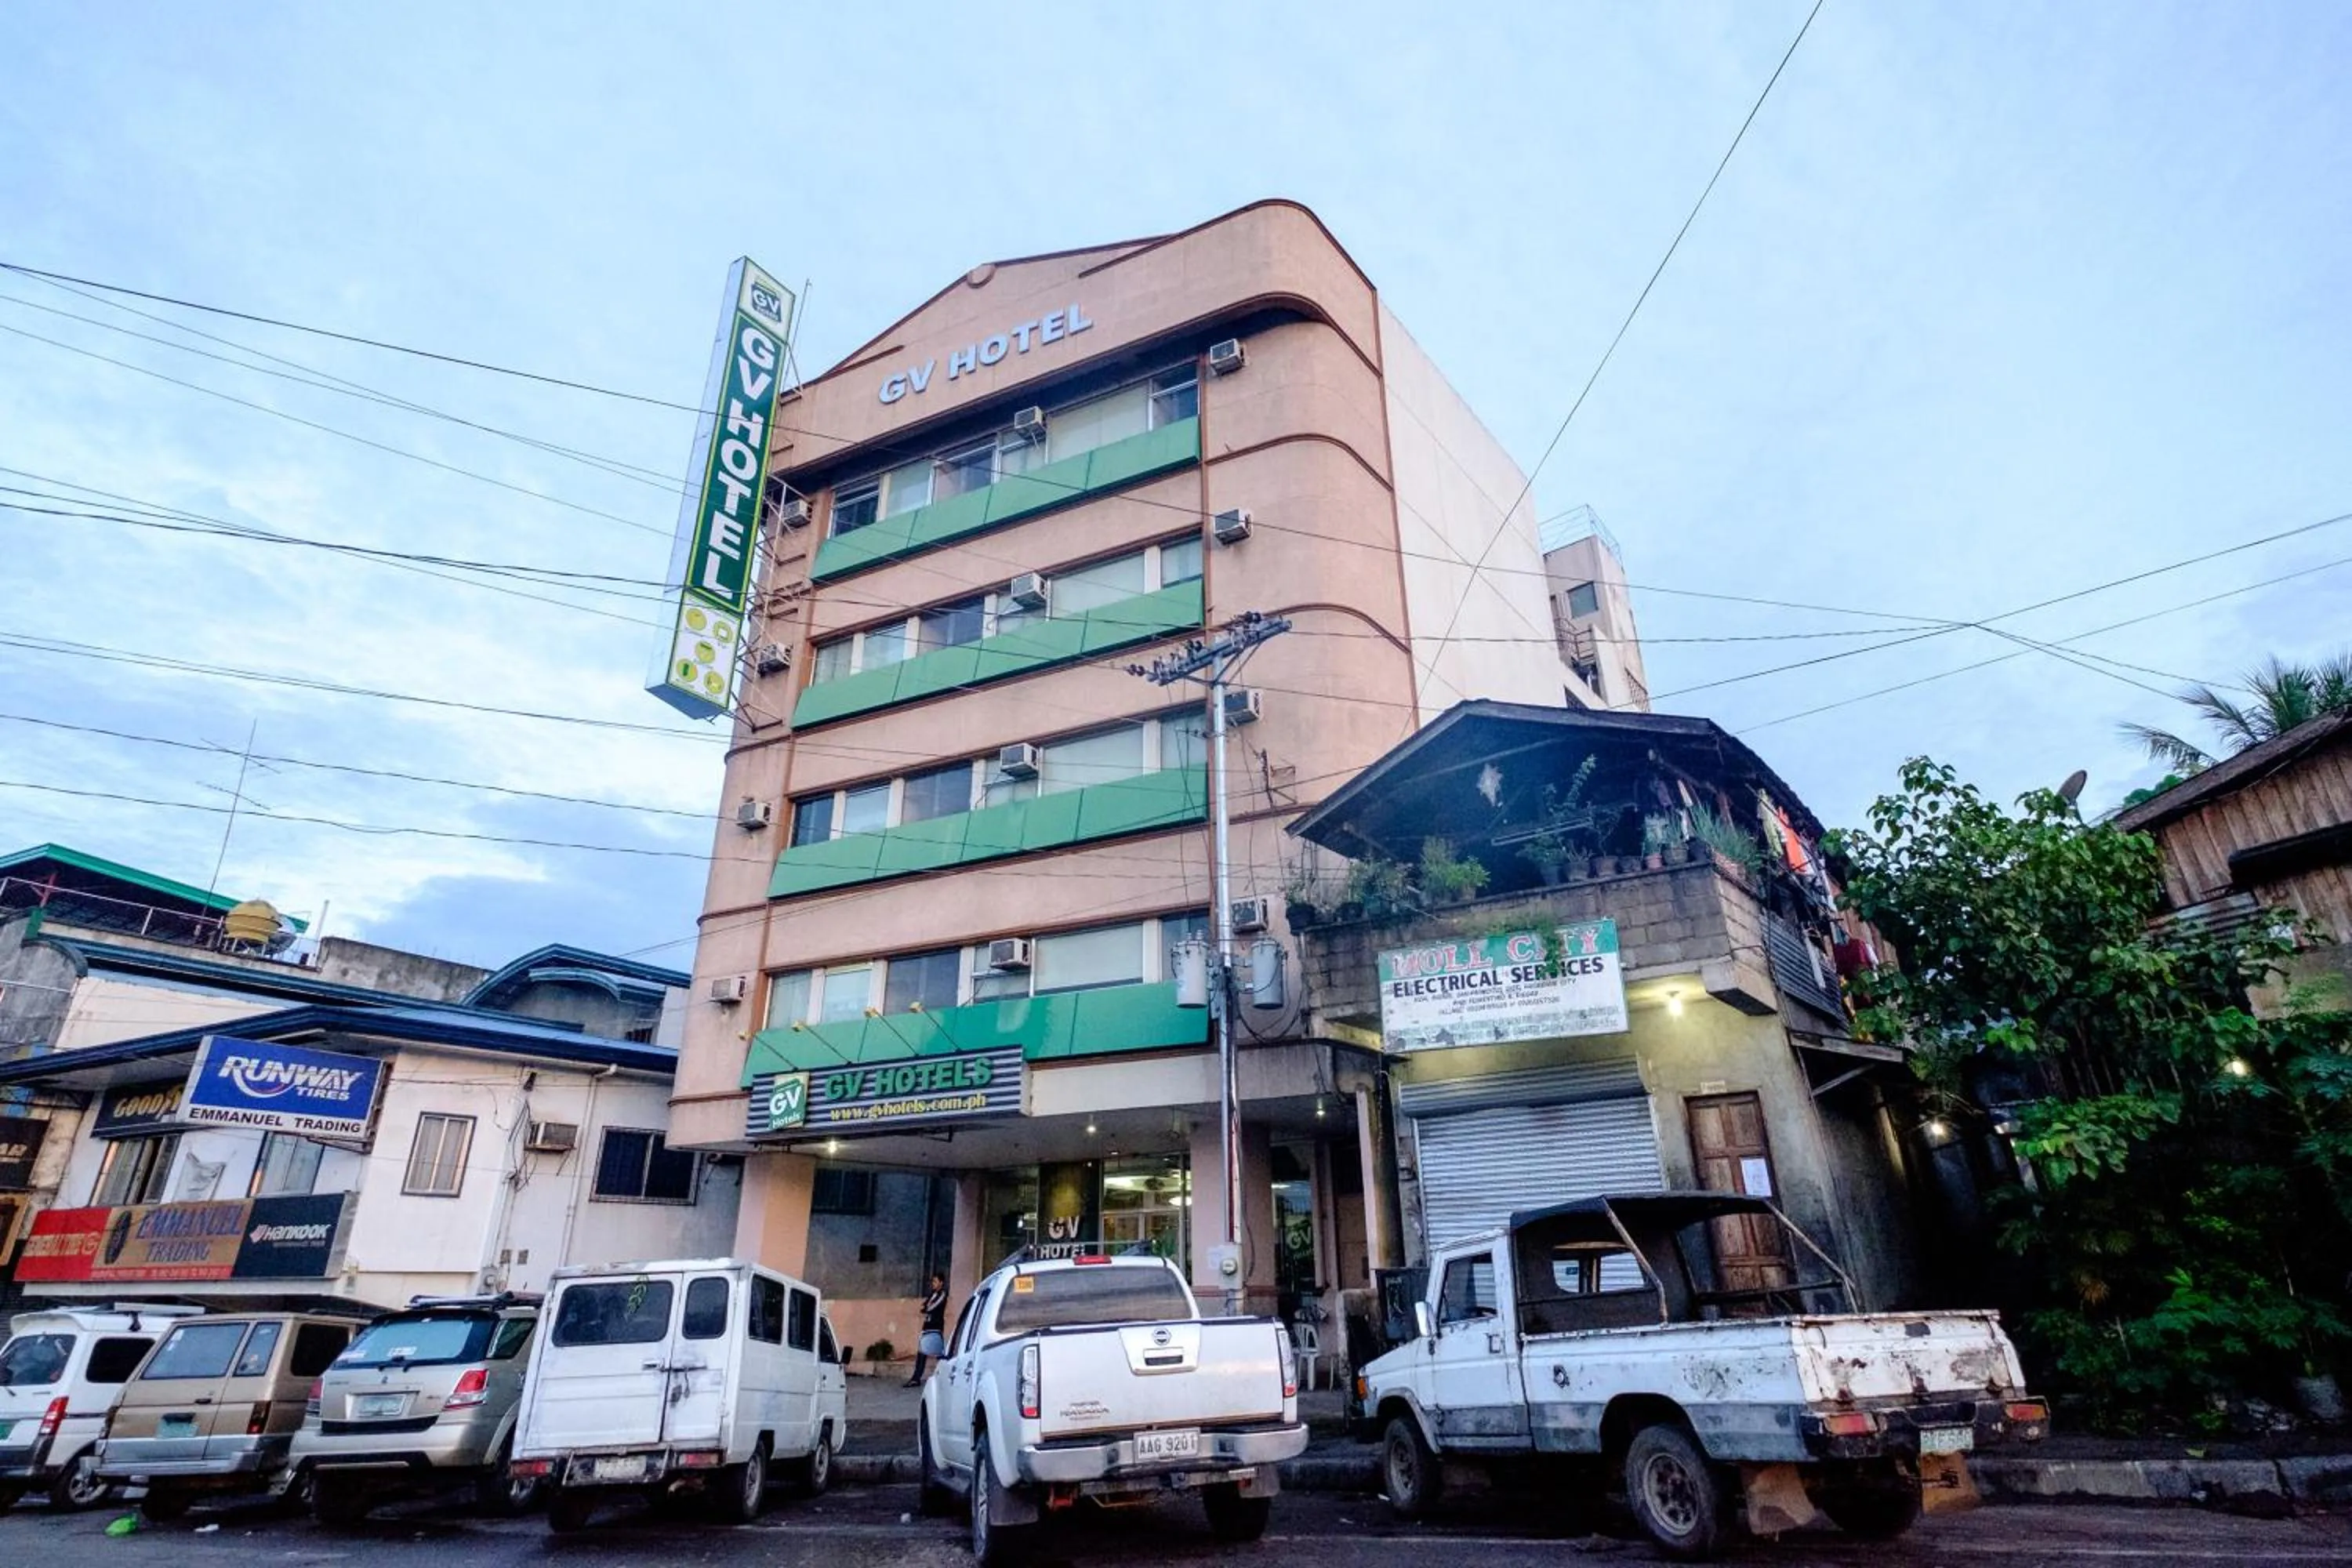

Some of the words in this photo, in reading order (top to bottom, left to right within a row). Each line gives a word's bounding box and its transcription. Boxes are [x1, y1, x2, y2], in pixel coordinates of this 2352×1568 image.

[753, 289, 780, 314] GV
[878, 358, 936, 405] GV
[948, 302, 1094, 381] HOTEL
[702, 397, 764, 600] HOTEL
[1394, 969, 1502, 998] ELECTRICAL
[218, 1056, 364, 1097] RUNWAY
[825, 1071, 866, 1099] GV
[874, 1058, 993, 1096] HOTELS
[296, 1086, 350, 1102] TIRES
[769, 1084, 802, 1116] GV
[830, 1093, 986, 1120] www.gvhotels.com.ph
[189, 1108, 283, 1127] EMMANUEL
[295, 1117, 361, 1133] TRADING
[772, 1112, 800, 1129] Hotels
[145, 1240, 213, 1262] TRADING
